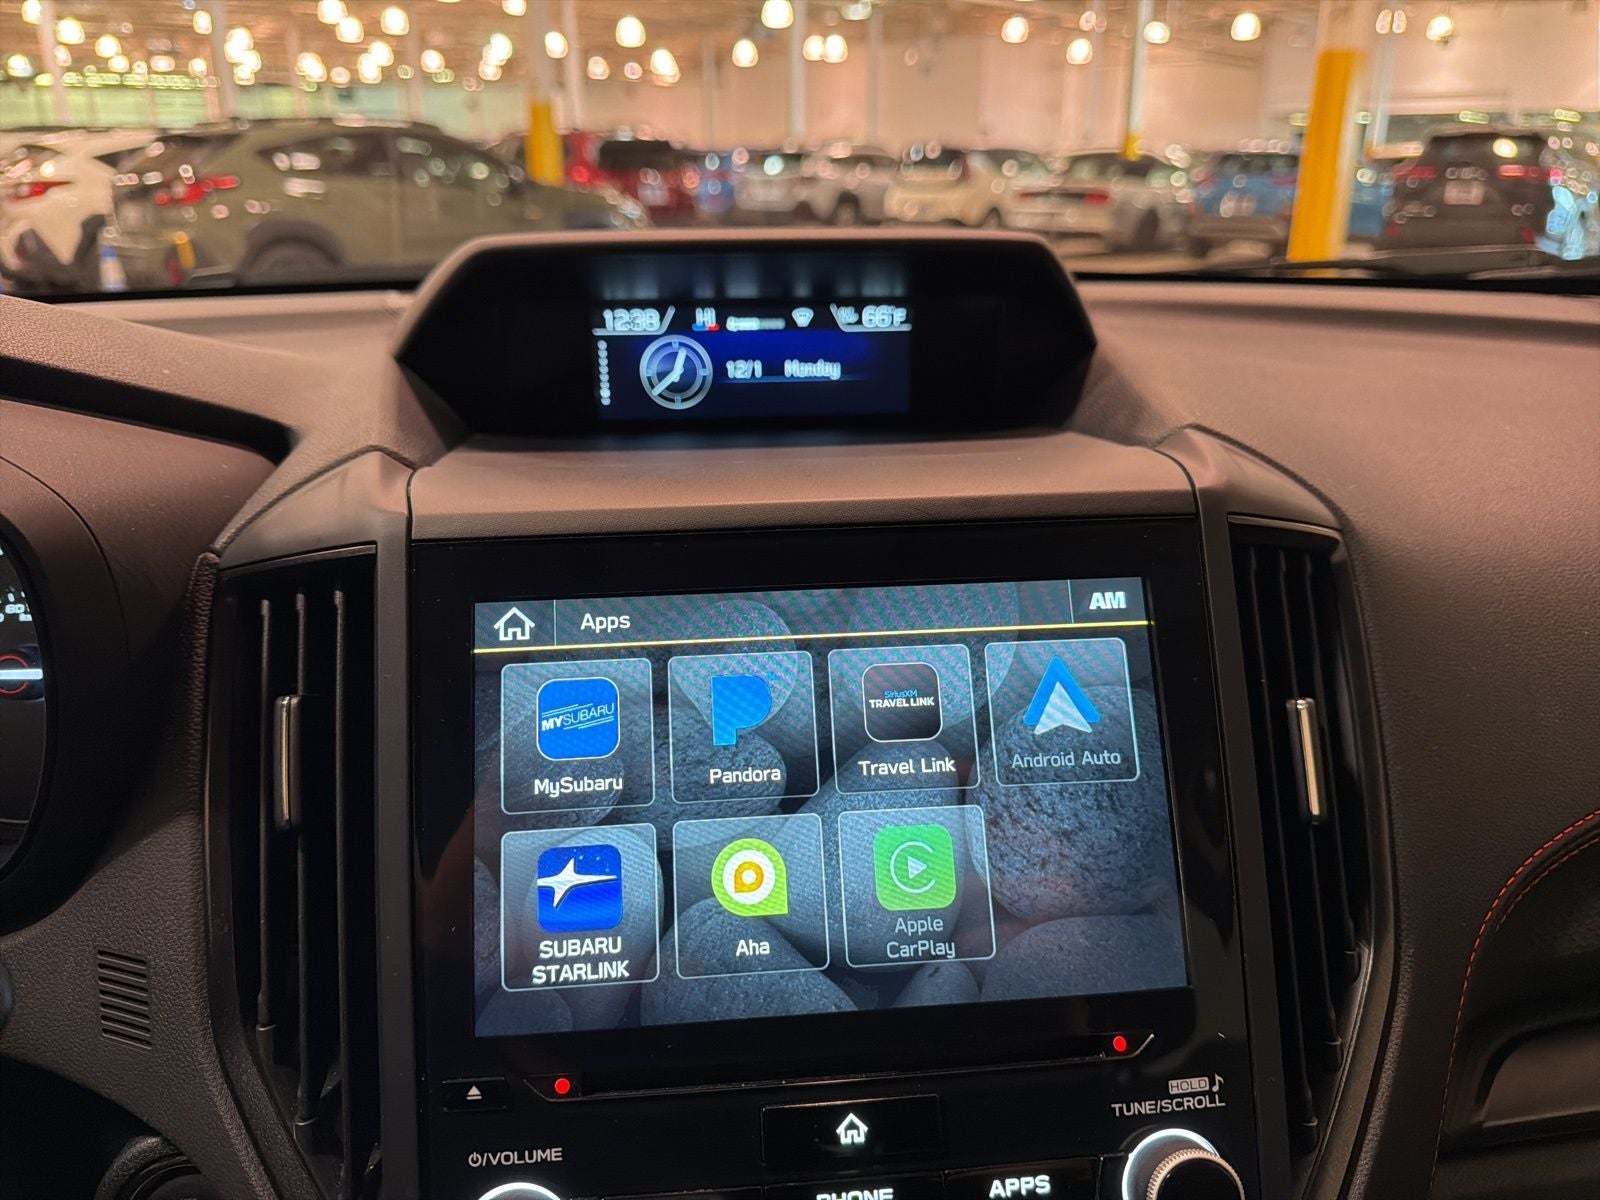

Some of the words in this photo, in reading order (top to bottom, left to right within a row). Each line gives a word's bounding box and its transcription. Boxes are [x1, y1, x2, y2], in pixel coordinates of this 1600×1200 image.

[784, 359, 841, 380] Monday
[1089, 591, 1126, 610] AM
[580, 613, 631, 633] Apps
[868, 698, 910, 708] TRAVEL
[910, 696, 935, 706] LINK
[884, 690, 918, 698] SiriusXM
[541, 702, 615, 731] MYSUBARU
[858, 759, 915, 776] Travel
[921, 757, 956, 773] Link
[1012, 753, 1075, 768] Android
[1082, 751, 1122, 765] Auto
[709, 767, 782, 784] Pandora
[534, 775, 623, 798] MySubaru
[895, 915, 944, 934] Apple
[539, 936, 622, 957] SUBARU
[735, 938, 770, 957] Aha
[886, 940, 956, 960] CarPlay
[532, 960, 630, 984] STARLINK
[1169, 1078, 1209, 1094] HOLD
[1111, 1094, 1226, 1117] TUNE/SCROLL
[989, 1175, 1051, 1199] APPS
